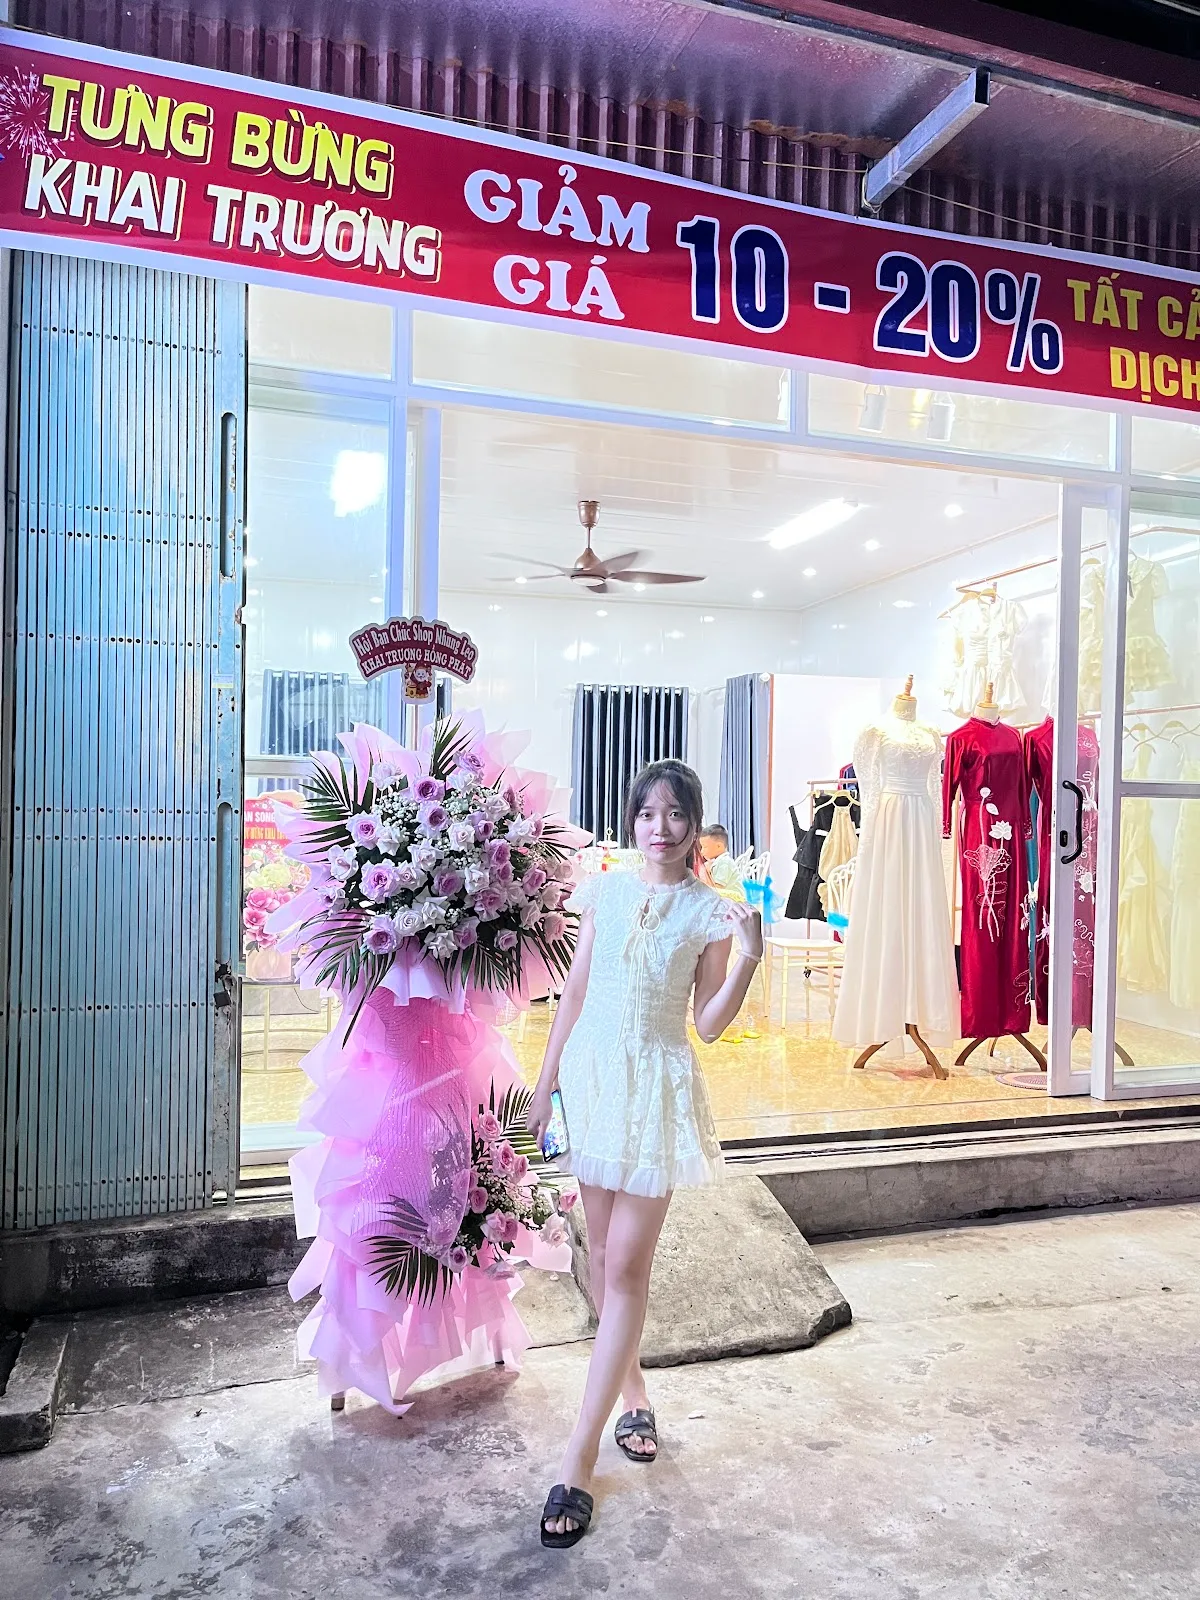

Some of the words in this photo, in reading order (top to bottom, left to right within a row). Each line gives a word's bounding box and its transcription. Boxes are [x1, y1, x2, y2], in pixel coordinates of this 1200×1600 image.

[42, 74, 211, 161] TƯNG
[231, 109, 393, 197] BỪNG
[24, 154, 185, 238] KHAI
[206, 184, 441, 281] TRƯƠNG
[464, 164, 651, 253] GIẢM
[493, 254, 625, 320] GIÁ
[676, 214, 789, 334] 10
[873, 250, 1064, 375] 20%
[1066, 272, 1144, 332] TẤT
[1109, 346, 1200, 402] DỊCH
[353, 633, 373, 656] Hội
[370, 630, 390, 649] Bạn
[389, 624, 412, 642] Chúc
[412, 623, 434, 645] Shop
[434, 627, 461, 655] Nhung
[361, 653, 387, 675] KHAI
[447, 659, 472, 677] PHÁT
